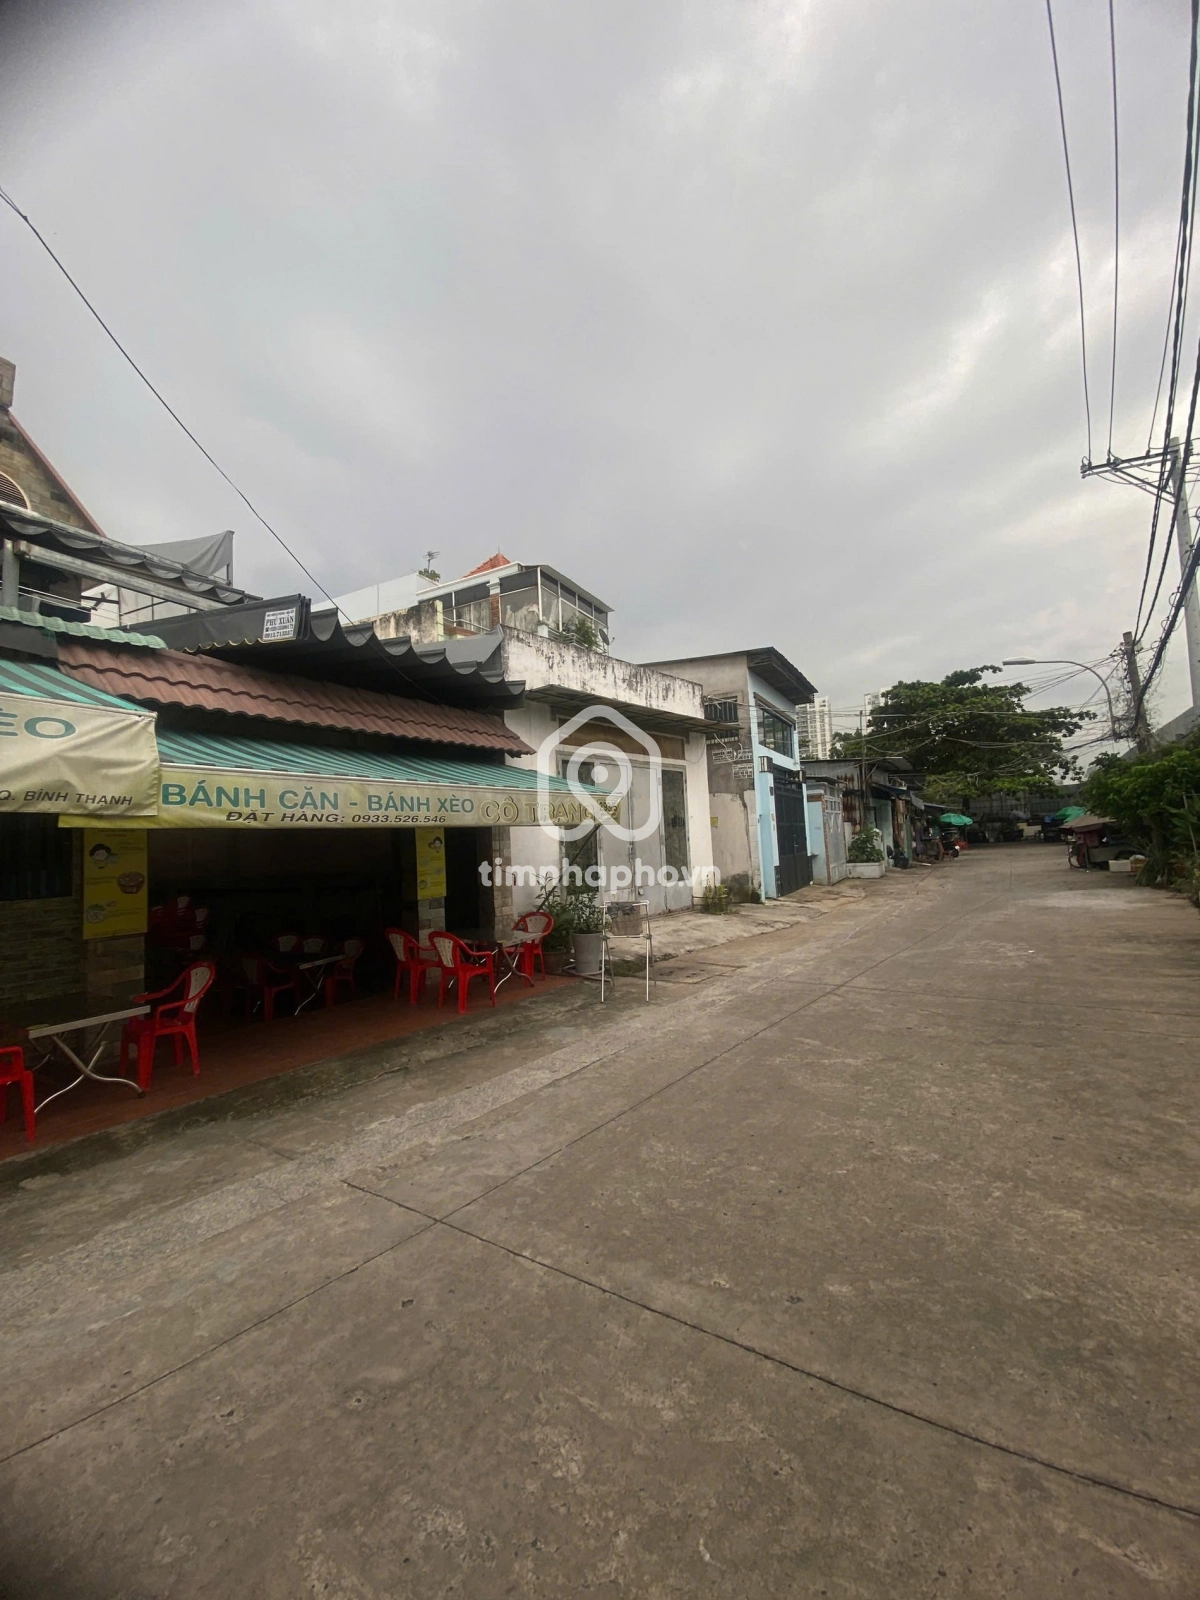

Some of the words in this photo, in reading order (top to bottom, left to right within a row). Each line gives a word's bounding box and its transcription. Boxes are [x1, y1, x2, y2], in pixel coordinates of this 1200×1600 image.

[23, 788, 69, 802] BÌNH
[161, 779, 266, 808] BÁNH
[278, 785, 340, 811] CĂN
[367, 791, 431, 813] BÁNH
[437, 794, 475, 814] XÈO
[480, 795, 519, 823] CÔ
[225, 809, 275, 824] ĐẶT
[280, 810, 346, 823] HÀNG:
[351, 814, 447, 824] 0933.526.546
